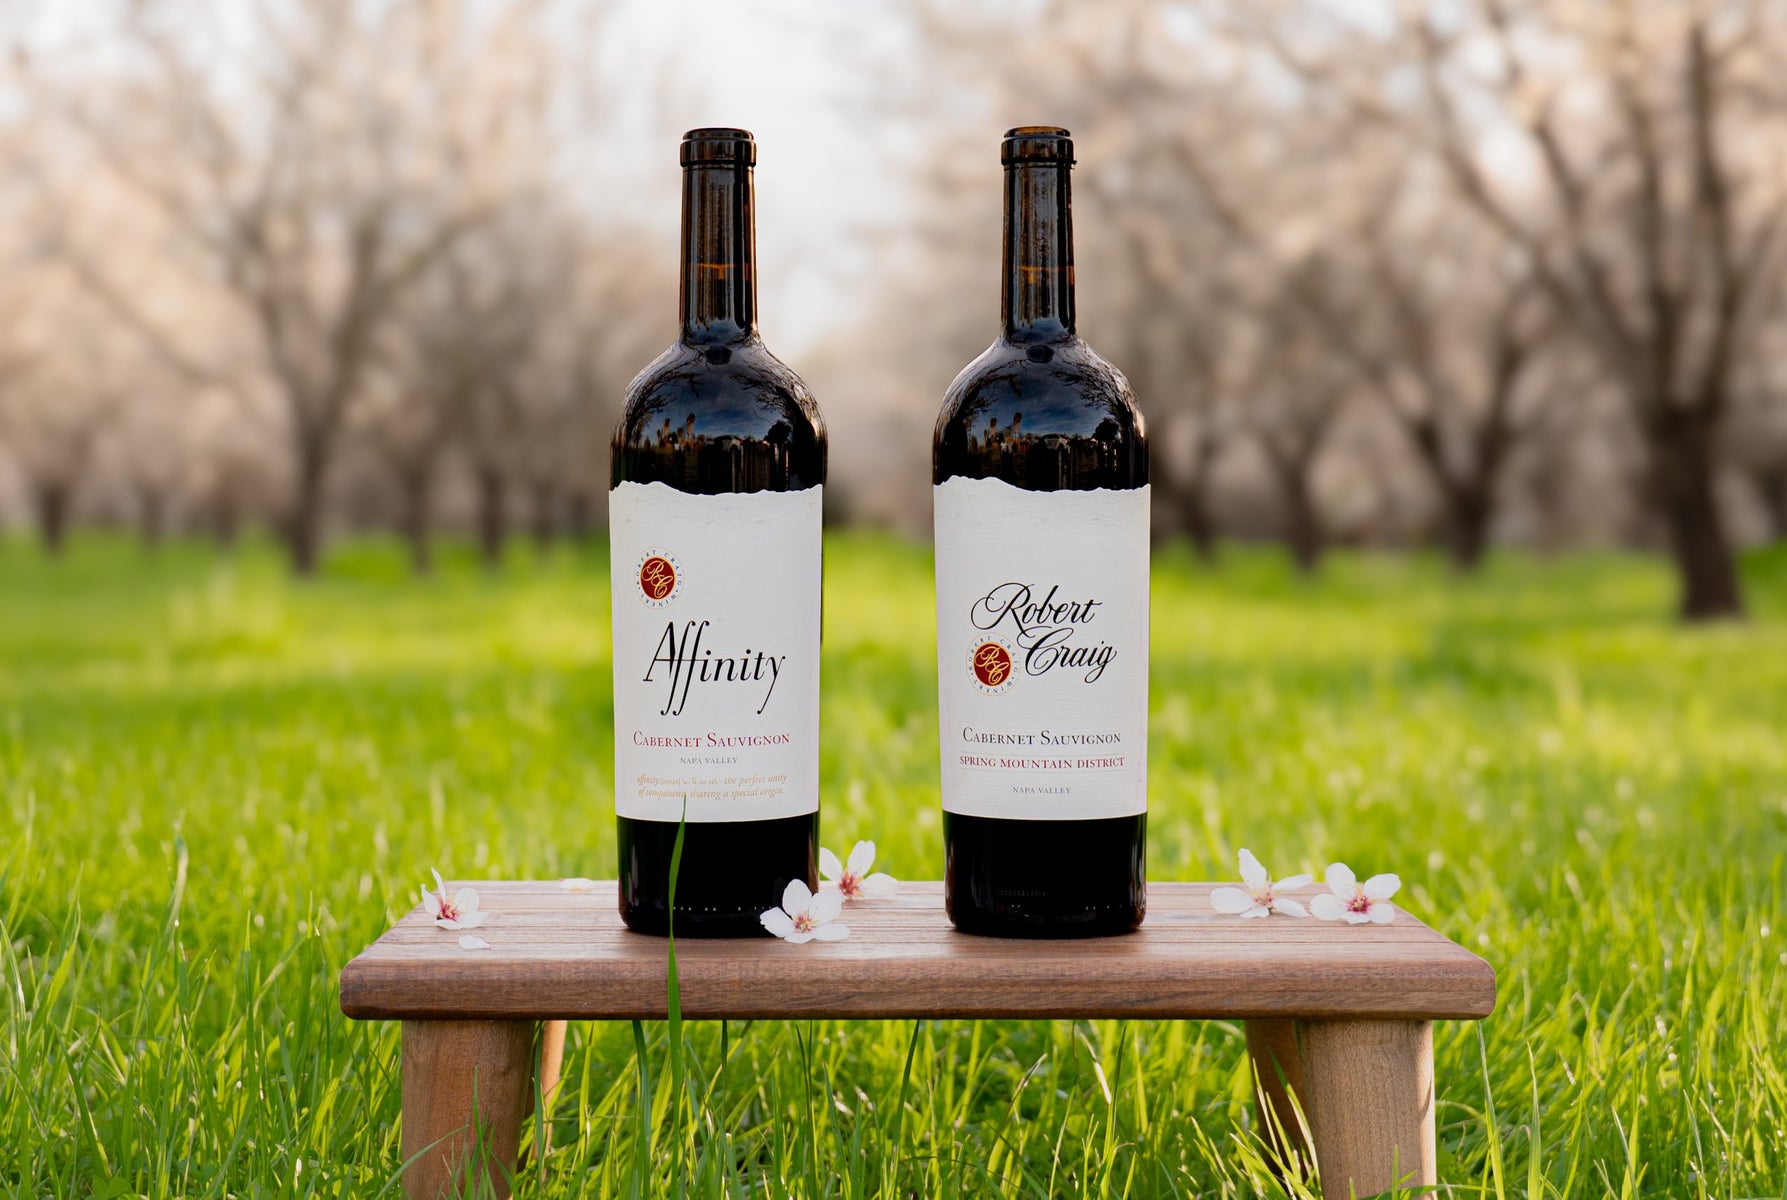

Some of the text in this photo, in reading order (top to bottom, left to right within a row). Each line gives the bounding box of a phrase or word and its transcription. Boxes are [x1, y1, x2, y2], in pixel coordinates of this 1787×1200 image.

[970, 582, 1103, 636] Robert
[1017, 626, 1117, 684] Craig
[642, 620, 786, 717] Affinity
[633, 731, 790, 748] CABERNET SAUVIGNON
[962, 726, 1121, 745] CABERNET SAUVIGNON
[680, 756, 738, 765] NAPA VALLEY
[959, 756, 1125, 769] SPRING MOUNTAIN DISTRICT
[723, 776, 737, 785] the
[738, 774, 766, 787] perfect
[767, 774, 788, 785] unity
[690, 788, 721, 800] sharing
[722, 790, 729, 798] a
[731, 787, 758, 800] special
[1012, 786, 1072, 794] NAPA VALLEY
